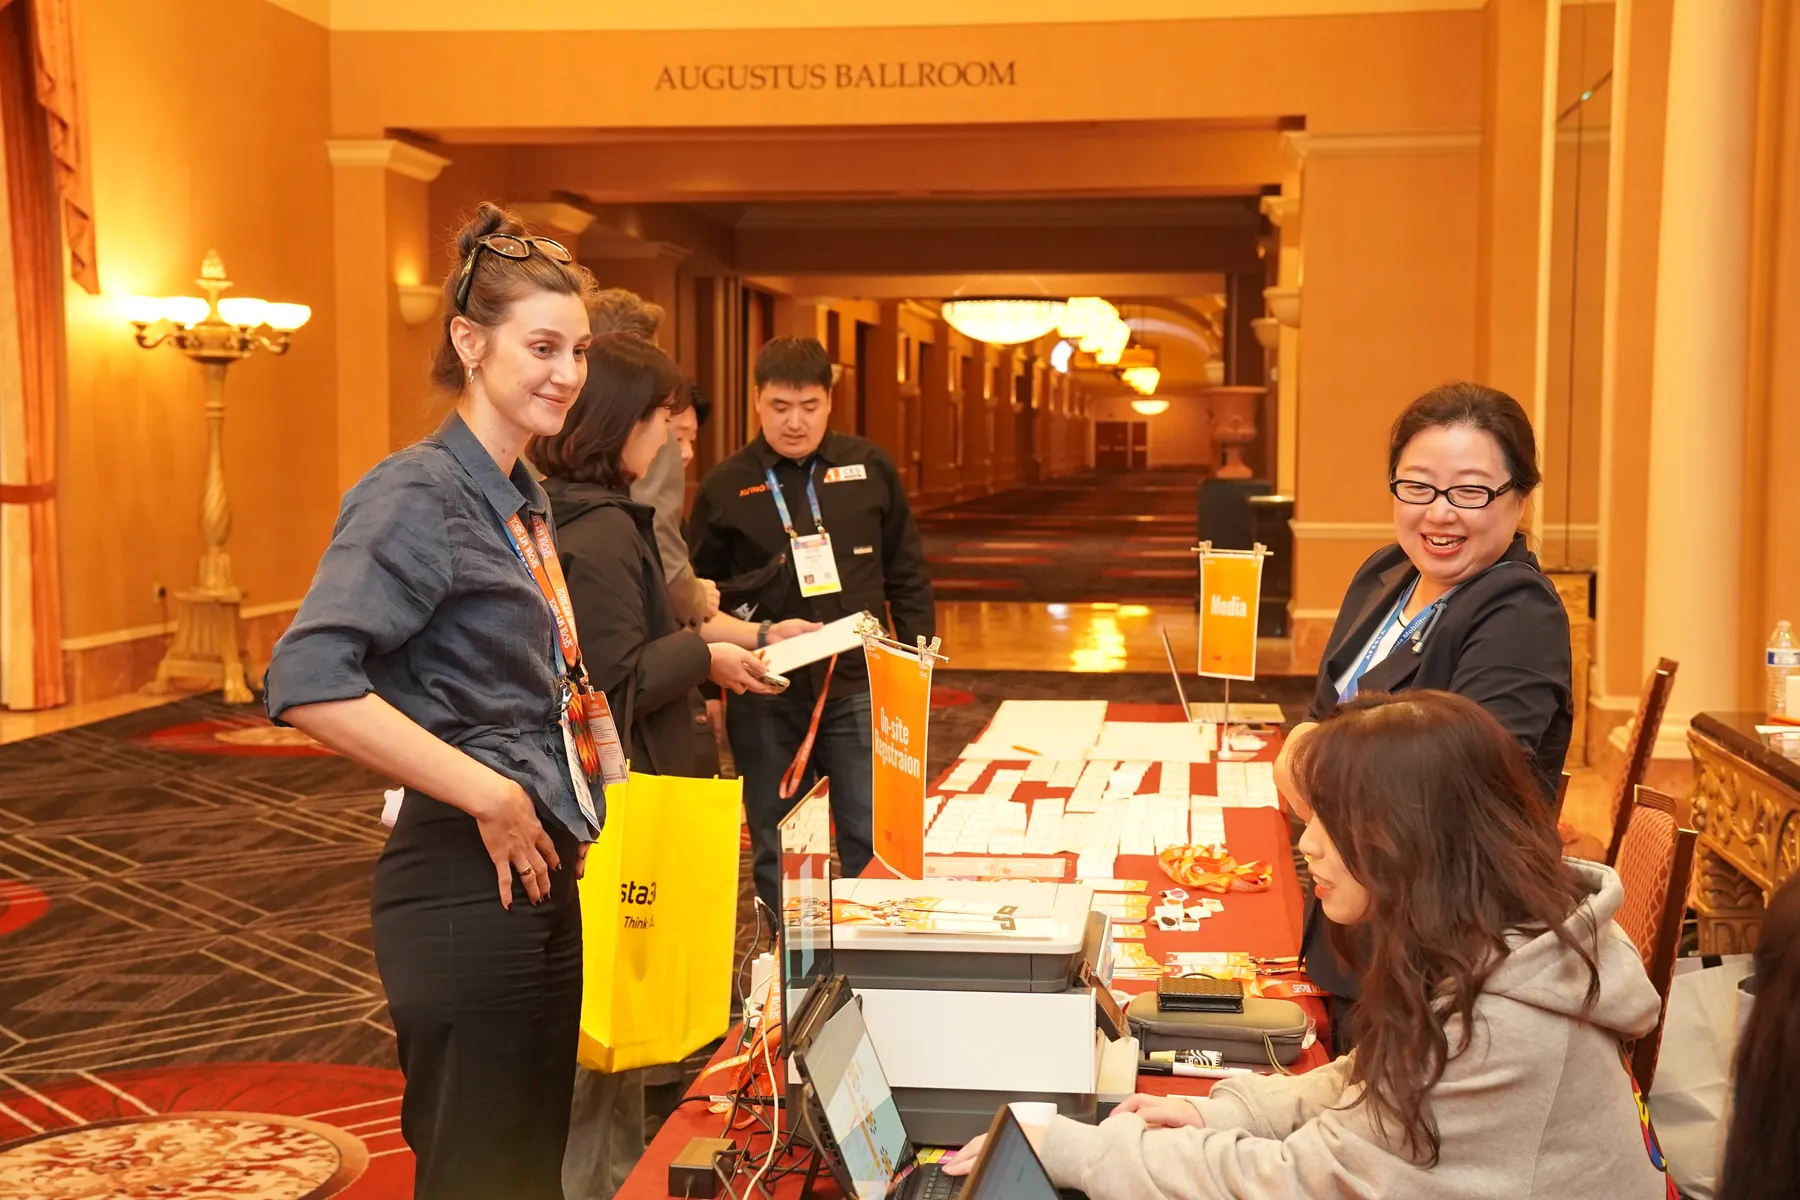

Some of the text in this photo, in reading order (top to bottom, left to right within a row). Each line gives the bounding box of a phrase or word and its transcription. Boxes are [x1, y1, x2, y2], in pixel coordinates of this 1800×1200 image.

[655, 61, 1018, 90] AUGUSTUS BALLROOM
[519, 535, 529, 547] MY
[1210, 594, 1248, 617] Media
[880, 706, 909, 745] On-site
[624, 915, 648, 929] Think
